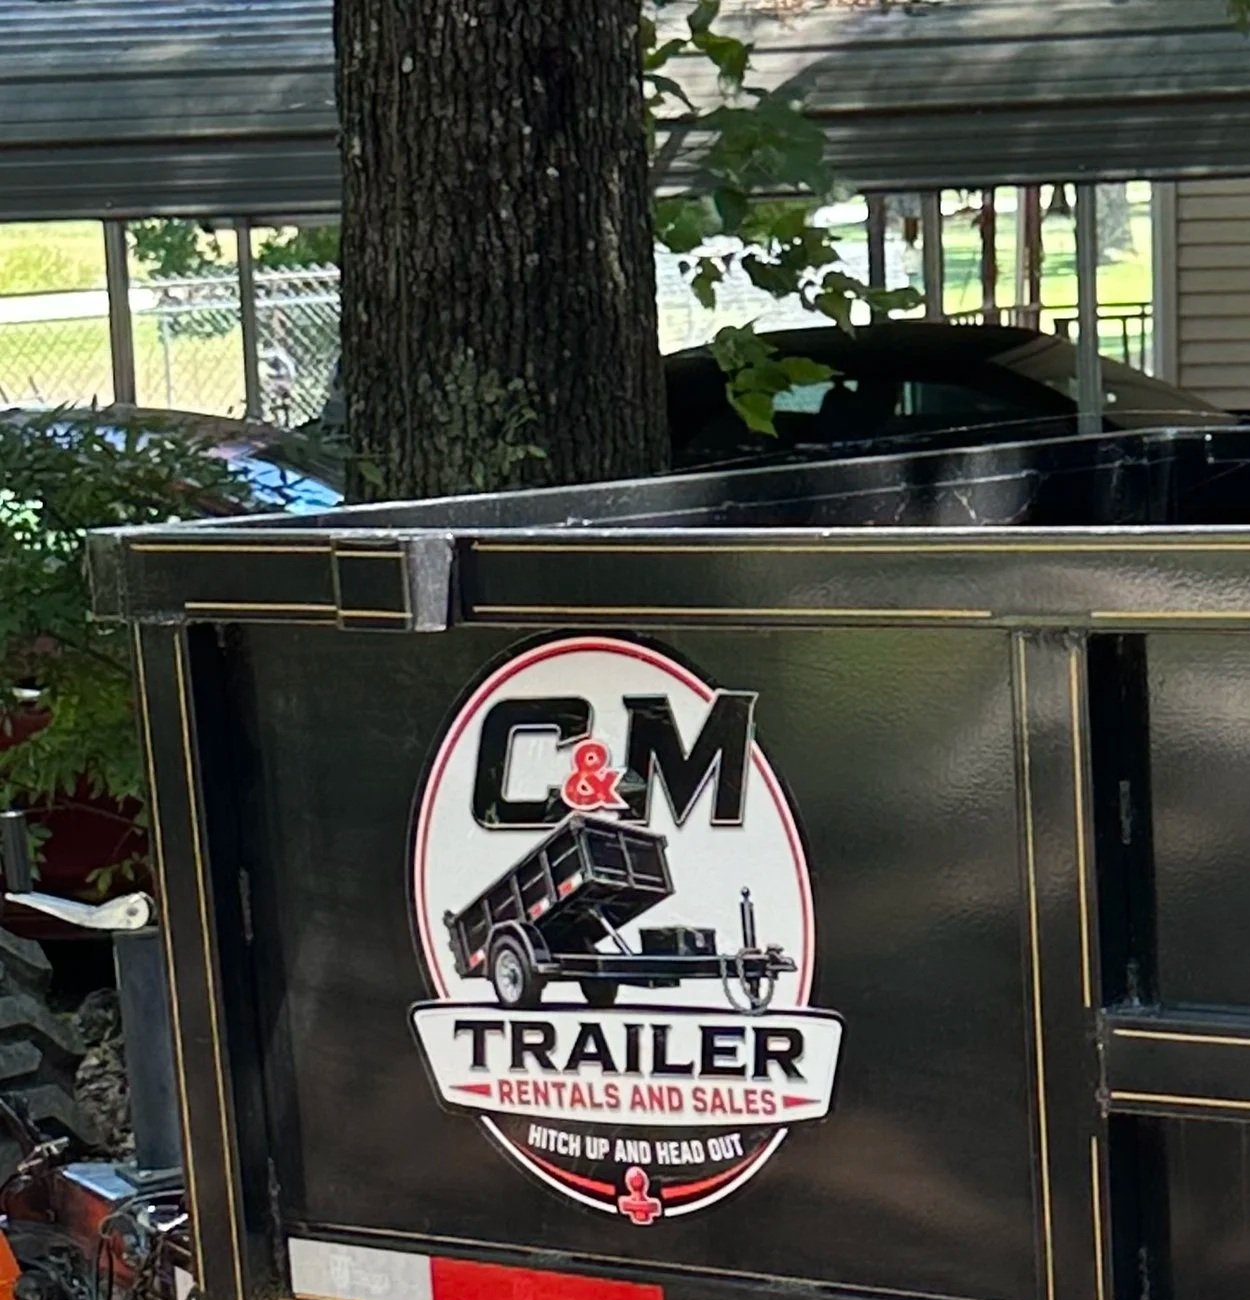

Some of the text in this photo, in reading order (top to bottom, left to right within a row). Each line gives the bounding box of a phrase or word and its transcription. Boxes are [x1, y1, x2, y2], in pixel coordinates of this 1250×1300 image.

[472, 690, 758, 830] C&M
[453, 1019, 806, 1082] TRAILER
[497, 1079, 777, 1116] RENTALS AND SALES
[528, 1123, 745, 1165] HITCH UP AND HEAD OUT
